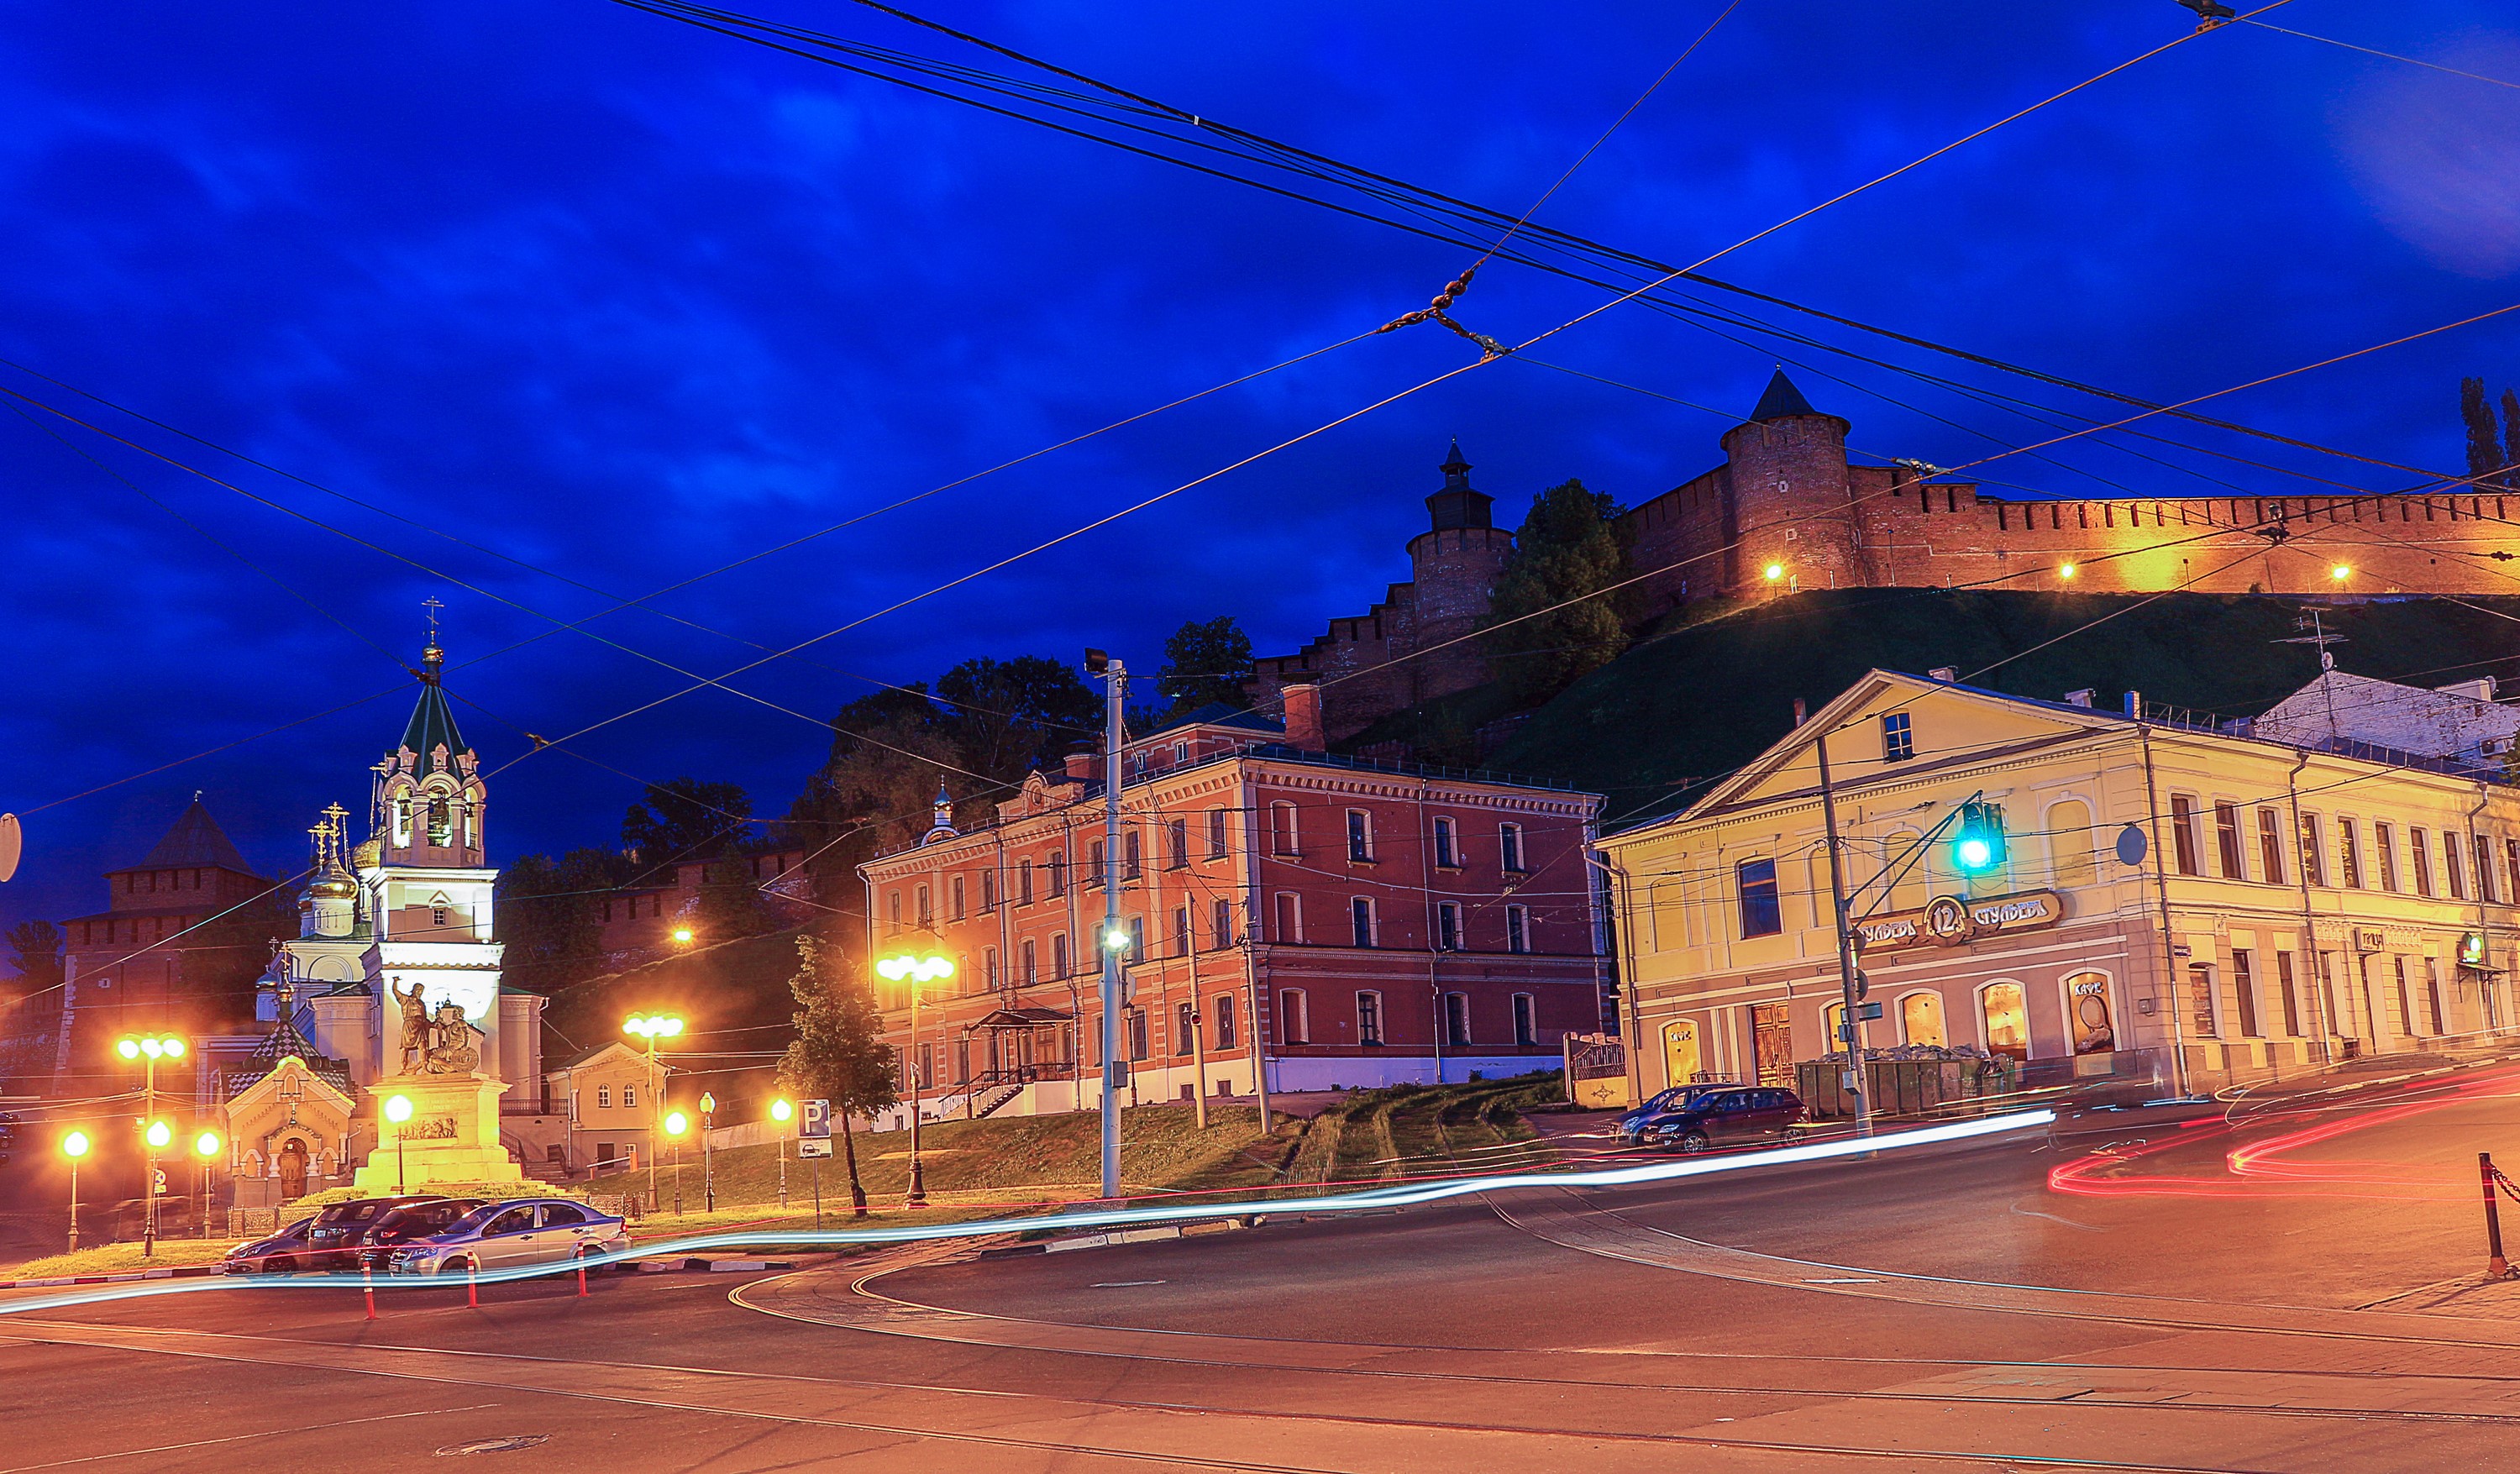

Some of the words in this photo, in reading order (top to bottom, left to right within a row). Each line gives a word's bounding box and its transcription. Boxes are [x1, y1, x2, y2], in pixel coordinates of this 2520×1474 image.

[1934, 907, 1956, 933] 12
[2075, 982, 2104, 995] КАФЕ
[803, 1104, 822, 1134] P
